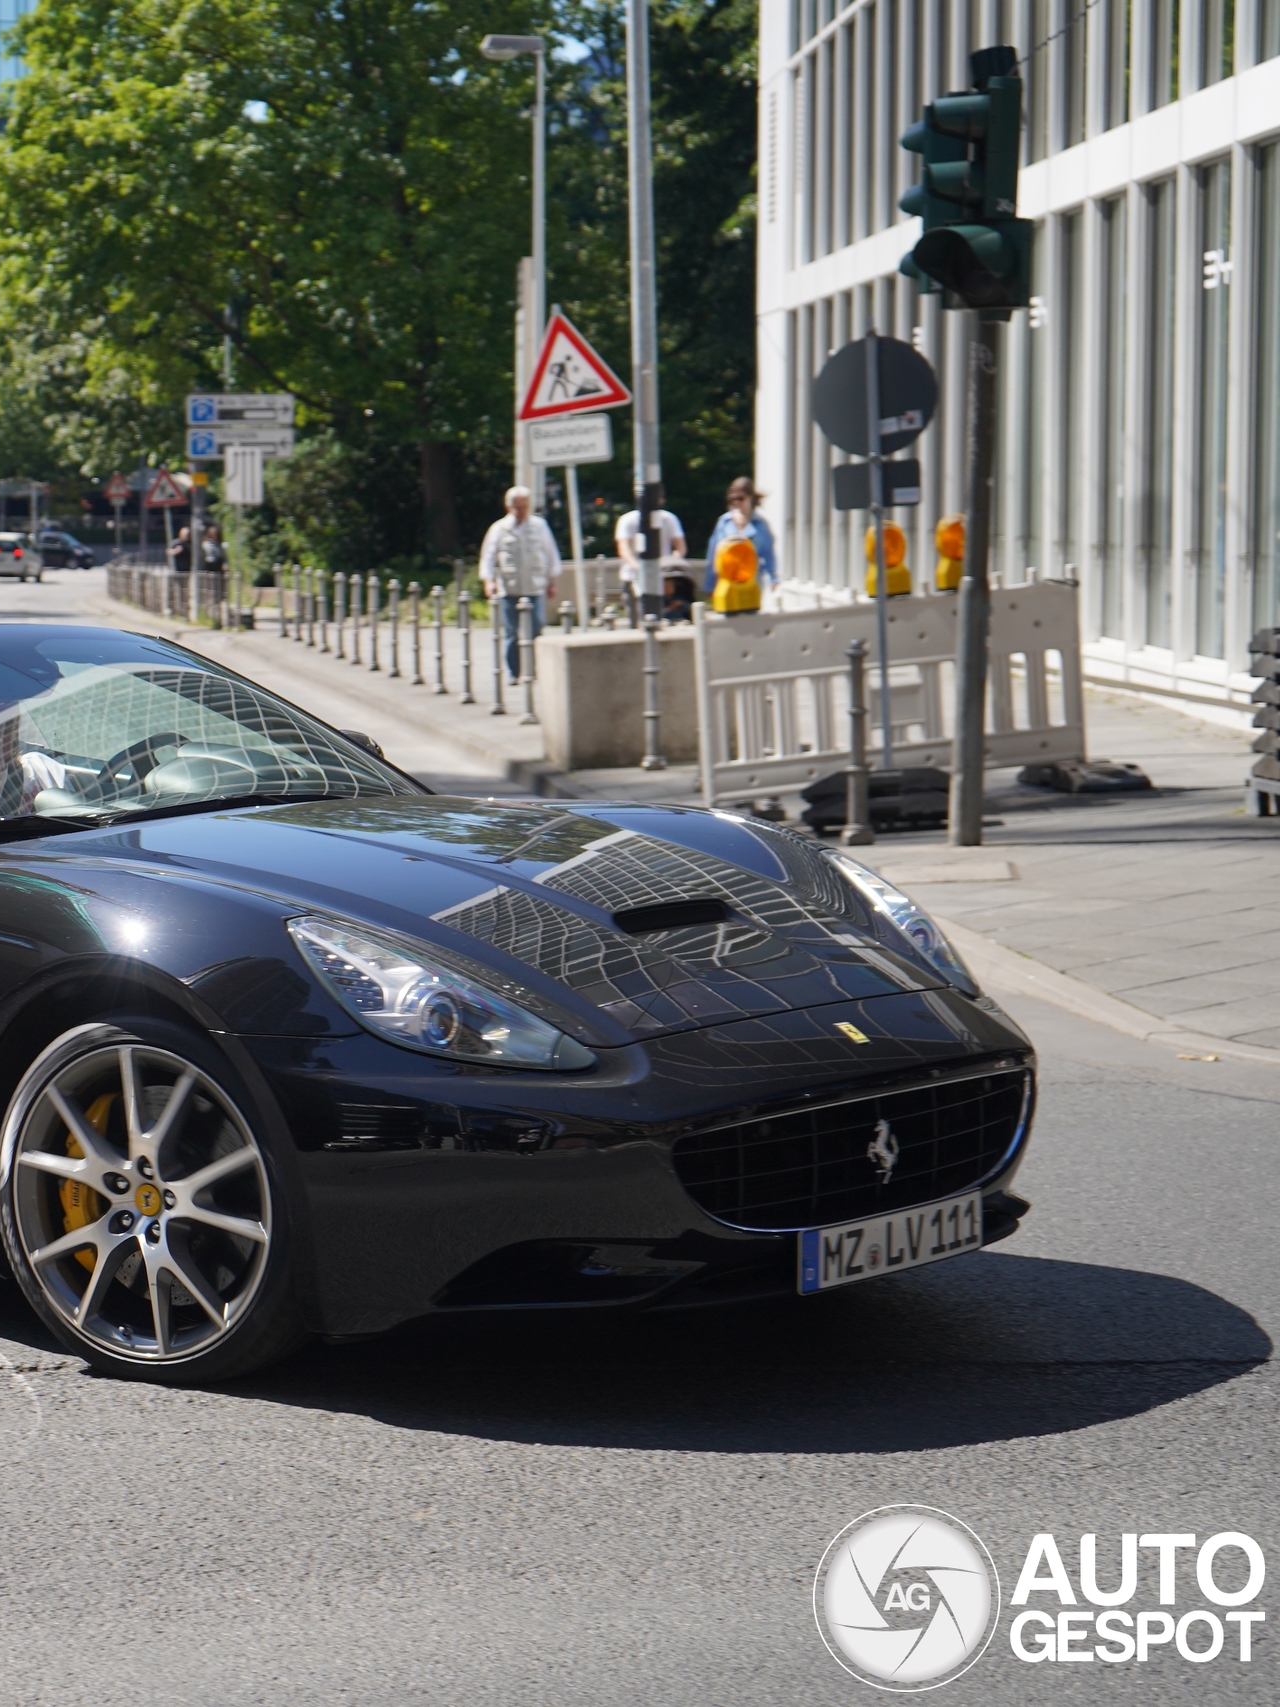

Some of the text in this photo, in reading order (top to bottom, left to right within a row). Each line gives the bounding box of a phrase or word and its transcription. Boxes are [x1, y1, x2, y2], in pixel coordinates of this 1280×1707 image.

[823, 1228, 864, 1281] MZ
[887, 1214, 925, 1266] LV
[931, 1200, 979, 1255] 111
